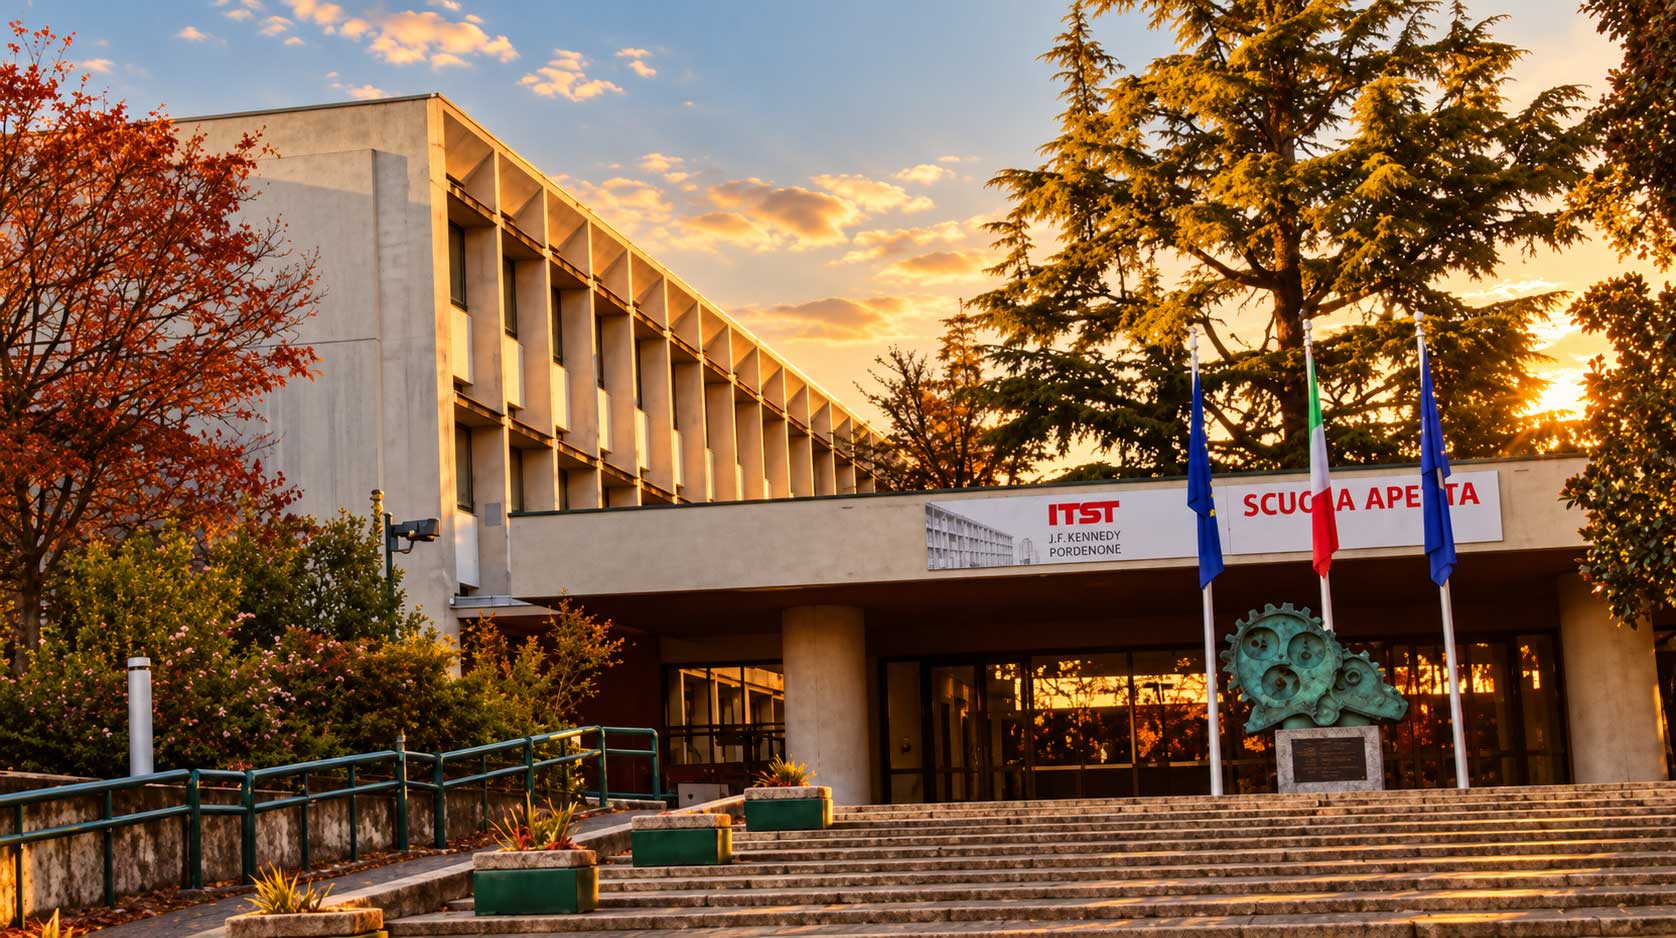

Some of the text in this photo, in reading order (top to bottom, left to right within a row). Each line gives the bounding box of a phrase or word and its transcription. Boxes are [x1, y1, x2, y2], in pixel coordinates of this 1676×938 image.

[1243, 482, 1480, 517] SCUOA APETA
[1048, 500, 1120, 526] ITST
[1049, 530, 1121, 544] J.F. KENNEDY
[1049, 544, 1121, 557] PORDENONE
